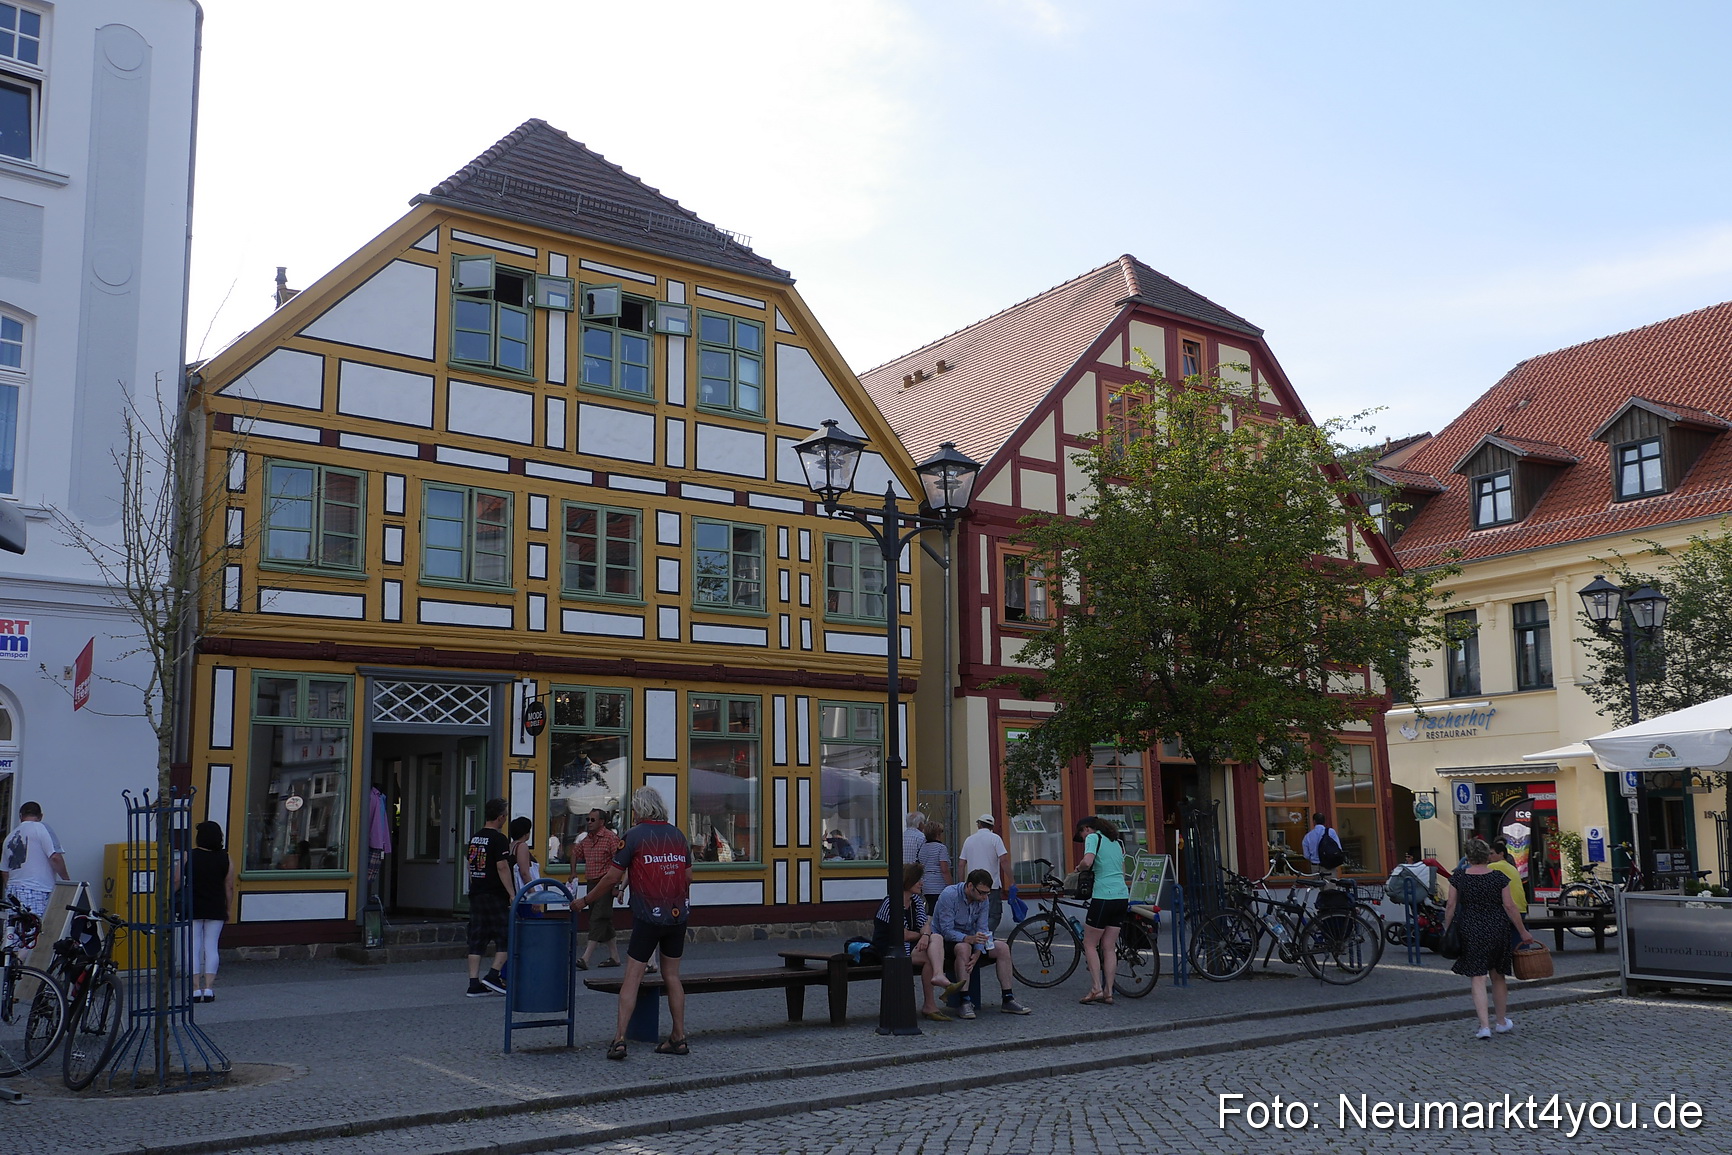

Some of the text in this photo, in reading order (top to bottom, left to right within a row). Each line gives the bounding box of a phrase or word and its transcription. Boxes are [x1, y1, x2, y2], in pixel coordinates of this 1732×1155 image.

[528, 711, 543, 720] MODE
[1426, 728, 1477, 739] RESTAURANT
[1515, 810, 1532, 818] ice
[643, 853, 686, 864] Davidson
